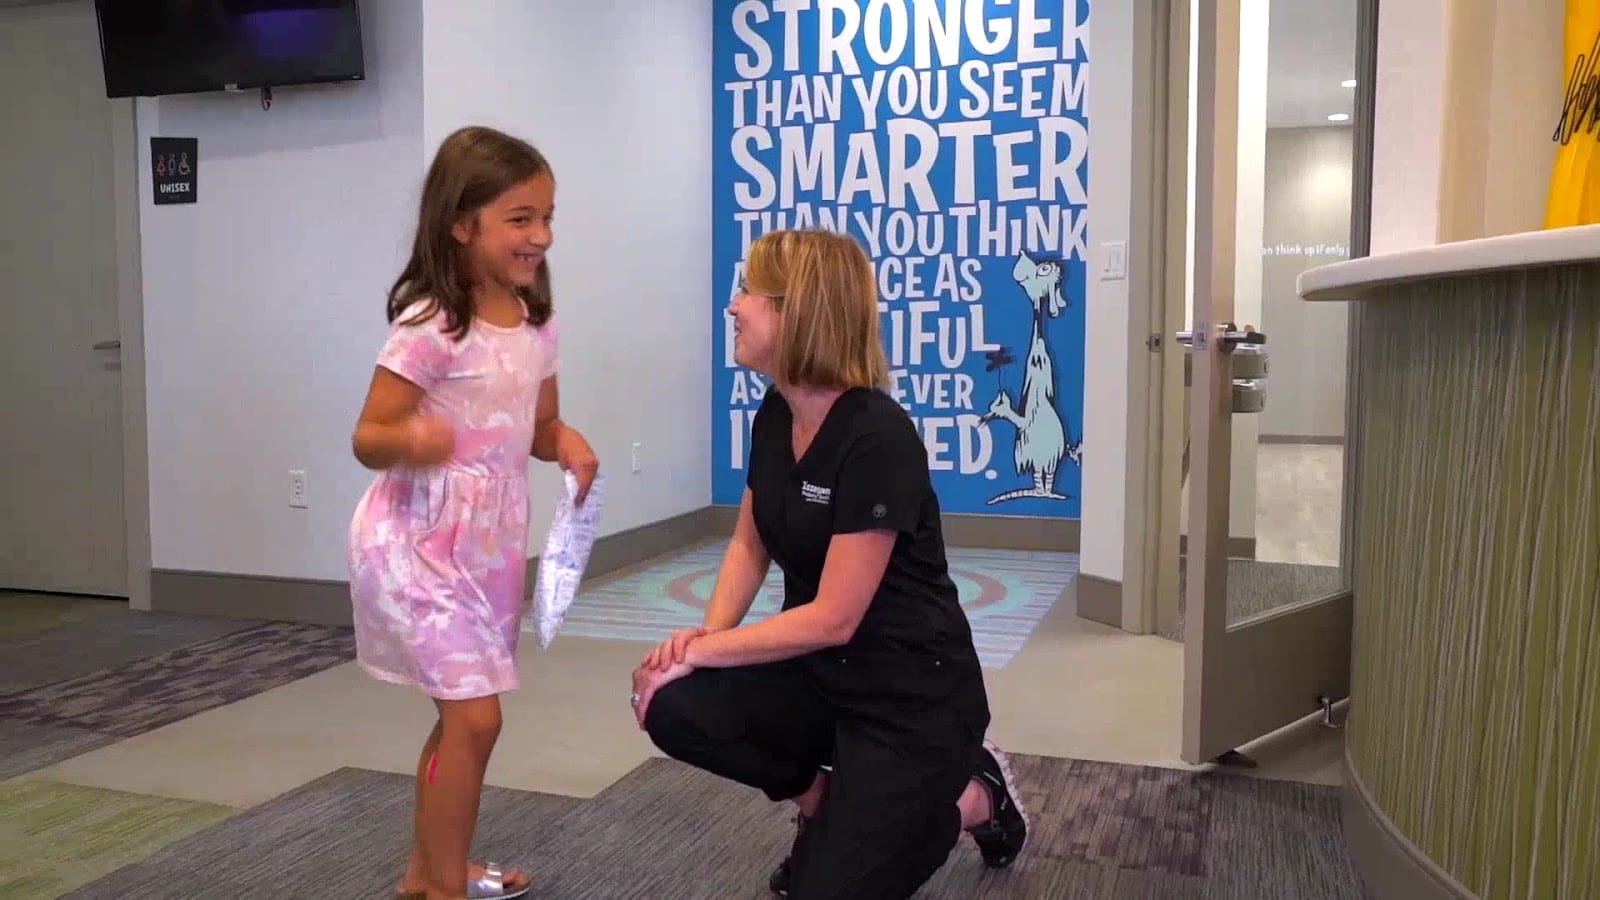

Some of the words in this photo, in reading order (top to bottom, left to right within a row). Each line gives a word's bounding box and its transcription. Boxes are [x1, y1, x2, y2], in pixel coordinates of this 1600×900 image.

[731, 0, 1090, 79] STRONGER
[725, 74, 842, 128] THAN
[851, 66, 948, 130] YOU
[959, 59, 1089, 118] SEEM
[160, 182, 190, 193] UNISEX
[731, 116, 1088, 212] SMARTER
[854, 206, 944, 258] YOU
[949, 200, 1088, 262] THINK
[1276, 243, 1303, 256] think
[933, 253, 982, 302] AS
[730, 370, 767, 405] AS
[888, 369, 974, 410] EVER
